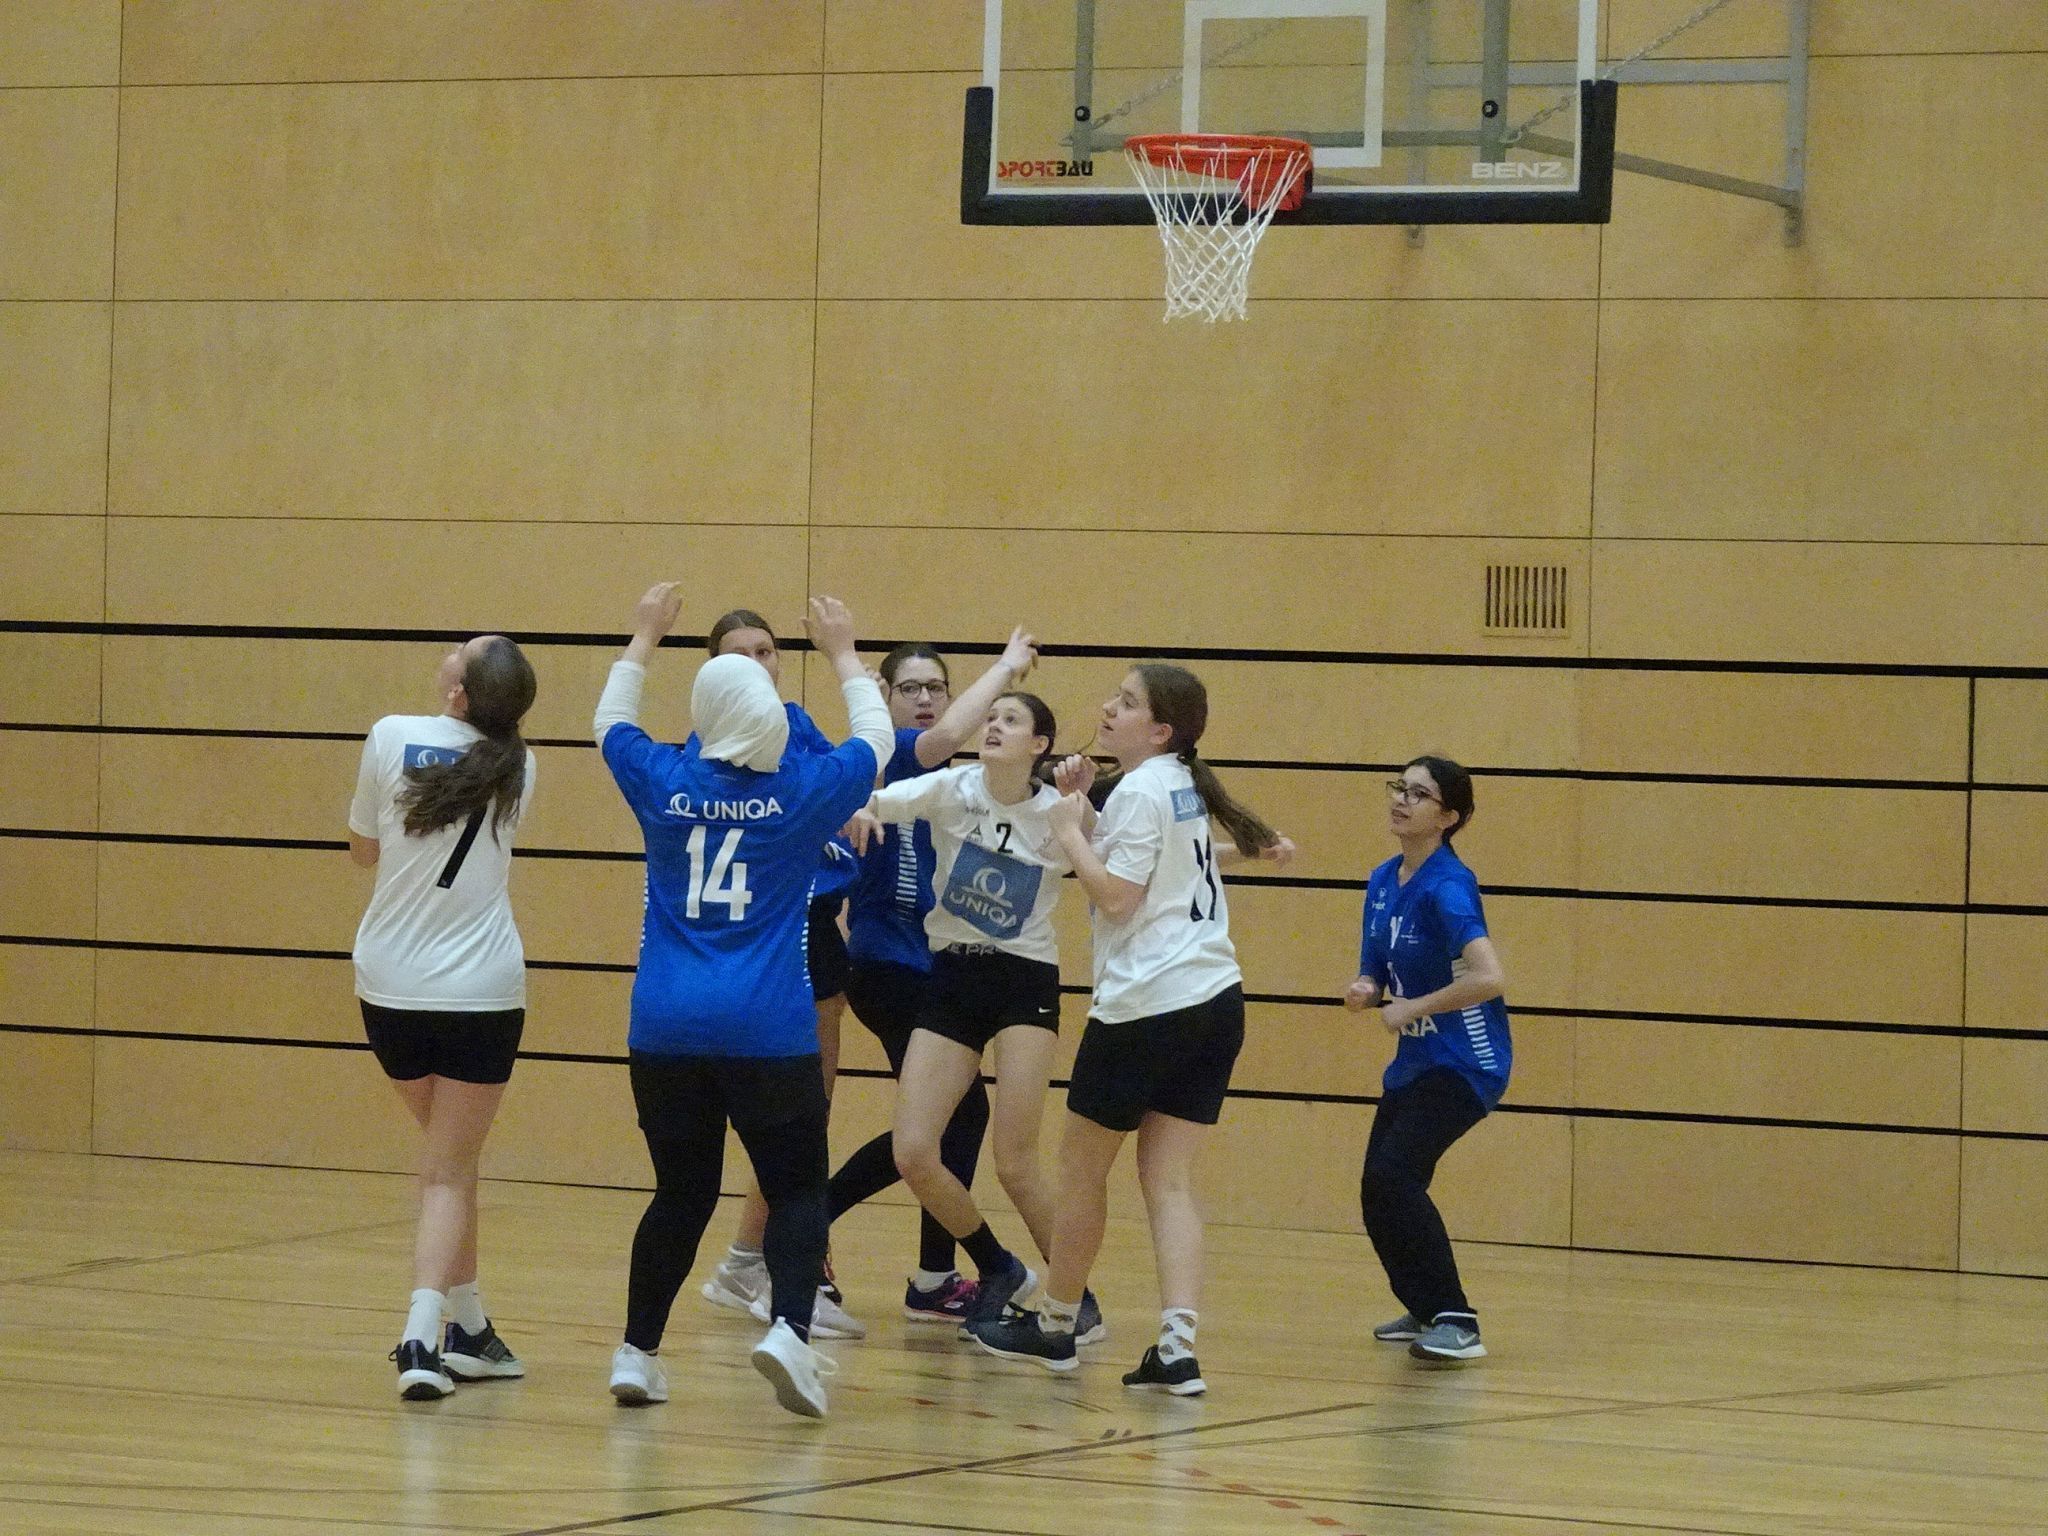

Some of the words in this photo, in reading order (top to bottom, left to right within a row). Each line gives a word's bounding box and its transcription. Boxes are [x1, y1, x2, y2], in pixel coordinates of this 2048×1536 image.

[1471, 161, 1562, 178] BENZ
[703, 797, 783, 820] UNIQA
[996, 823, 1014, 854] 2
[686, 825, 752, 921] 14
[950, 891, 1018, 929] UNIQA
